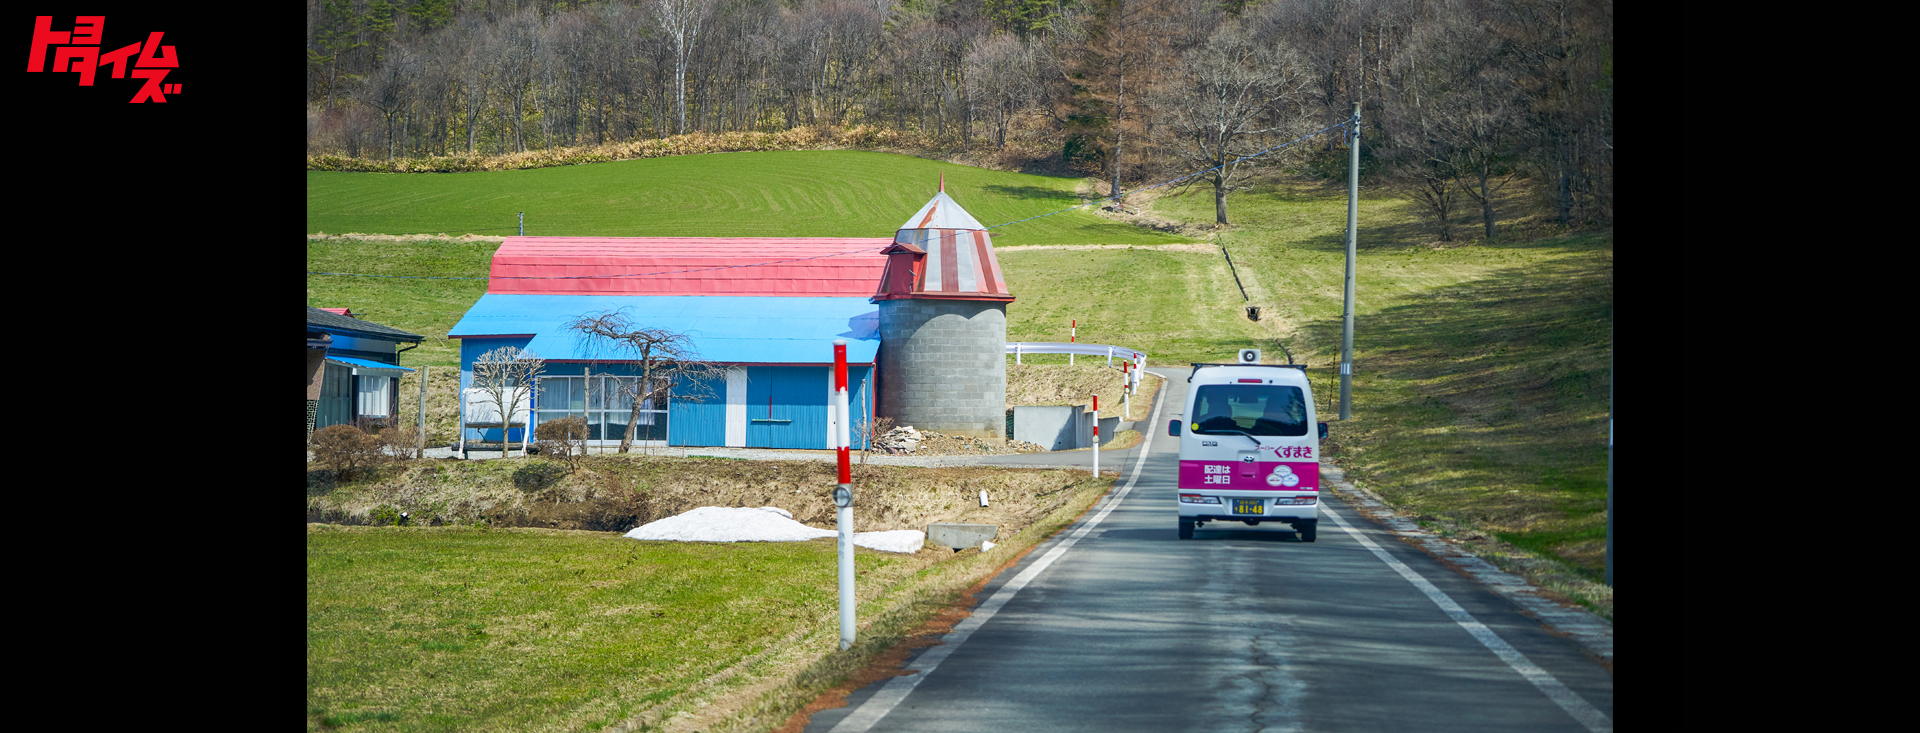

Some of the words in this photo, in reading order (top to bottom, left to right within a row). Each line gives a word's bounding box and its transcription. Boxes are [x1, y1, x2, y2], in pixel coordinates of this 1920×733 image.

[1274, 445, 1312, 459] くずまき
[1204, 465, 1231, 474] 配達は
[1204, 475, 1230, 484] 土曜日
[1239, 505, 1263, 514] 81-48
